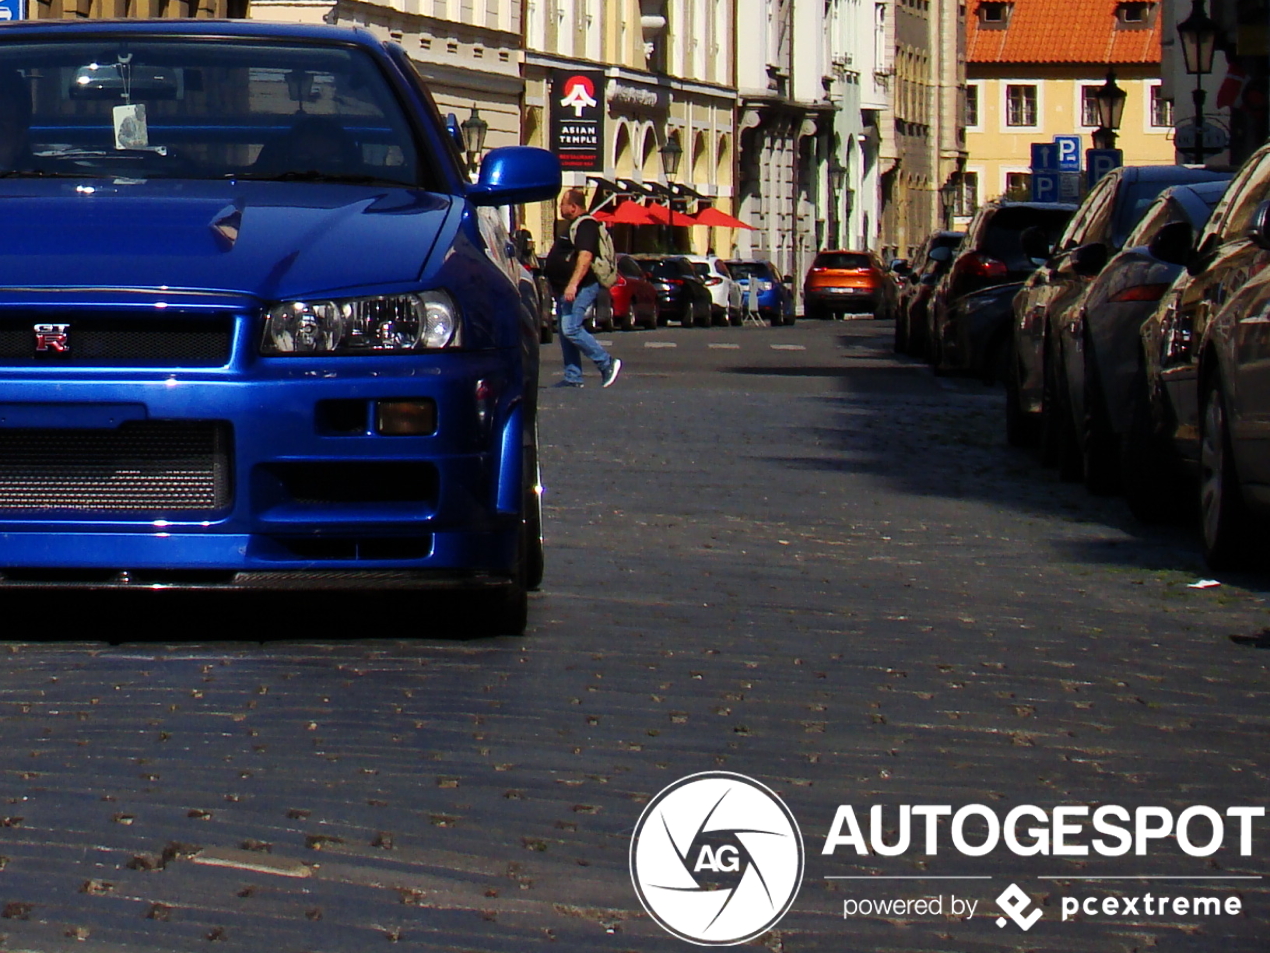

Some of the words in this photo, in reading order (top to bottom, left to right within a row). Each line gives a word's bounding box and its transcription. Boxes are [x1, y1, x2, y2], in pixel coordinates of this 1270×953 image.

[561, 126, 596, 135] ASIAN
[559, 135, 597, 144] TEMPLE
[1059, 139, 1076, 161] P
[1037, 177, 1053, 199] P
[33, 323, 71, 333] GT
[36, 333, 69, 353] R
